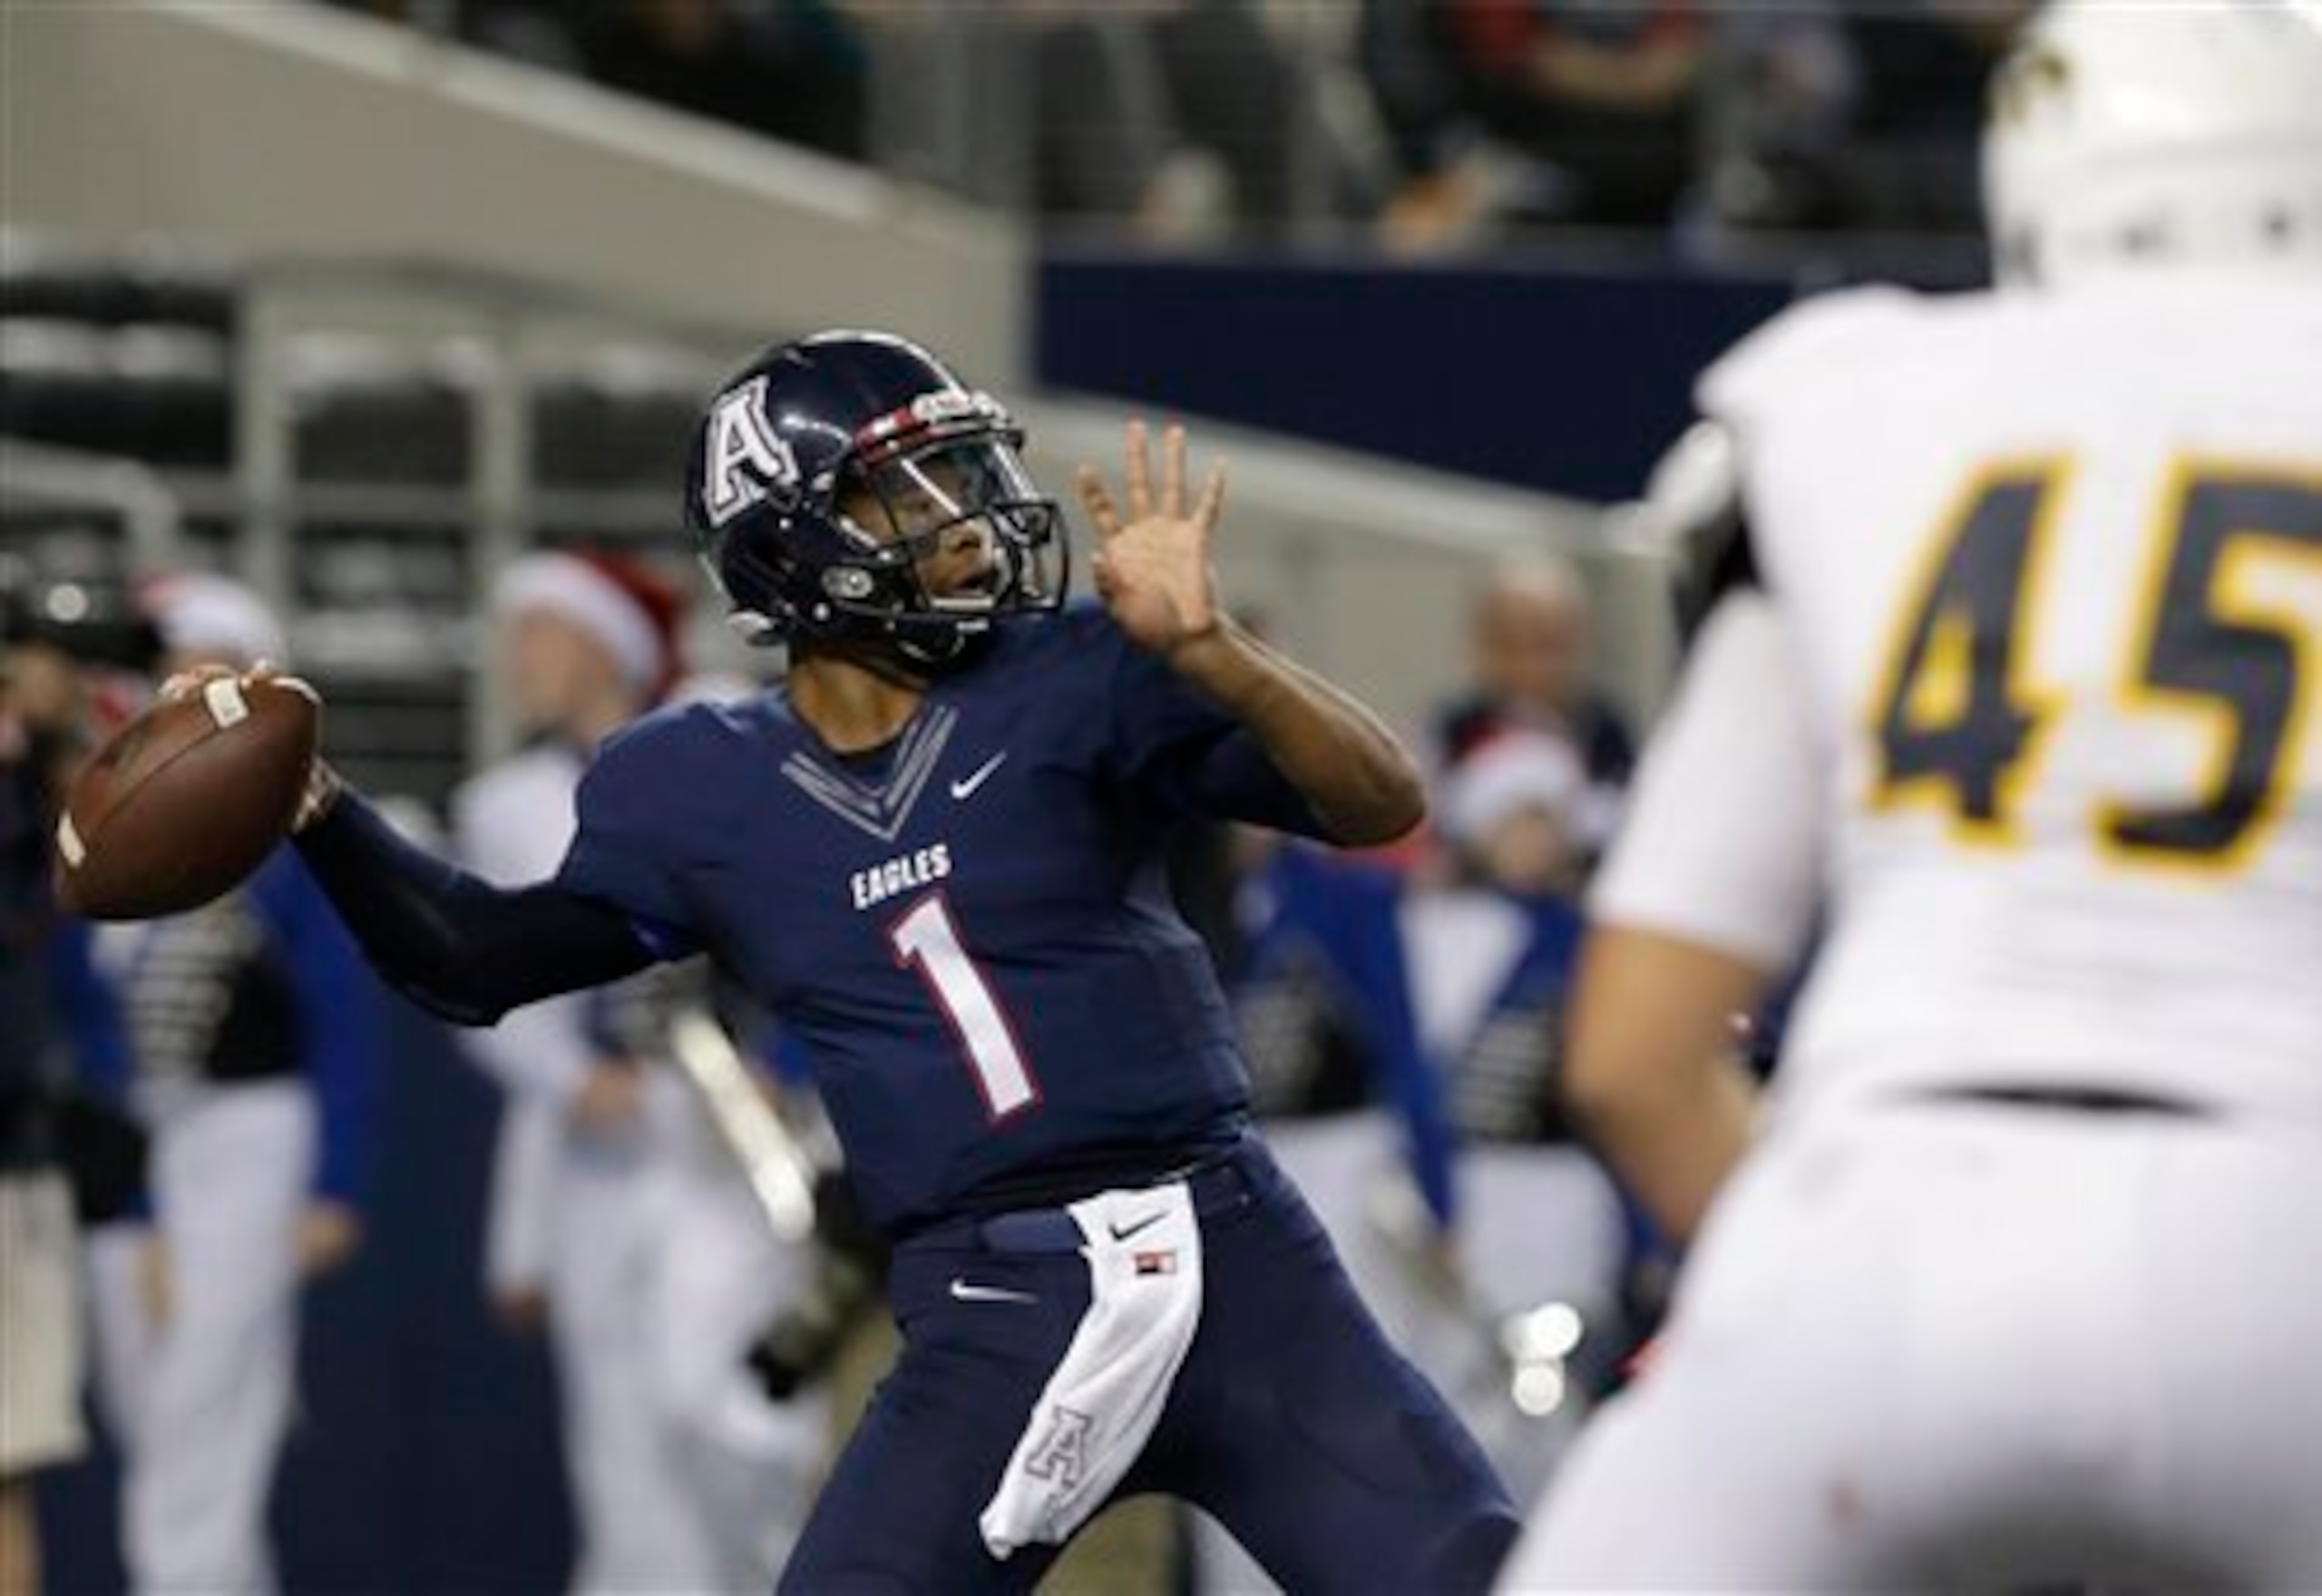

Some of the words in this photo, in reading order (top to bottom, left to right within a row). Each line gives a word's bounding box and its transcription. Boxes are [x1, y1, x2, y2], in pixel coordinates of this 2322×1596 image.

[704, 375, 800, 525] A
[1867, 455, 2322, 863] 45
[851, 843, 952, 910] EAGLES
[887, 892, 1040, 1124] 1
[1025, 1405, 1092, 1504] A
